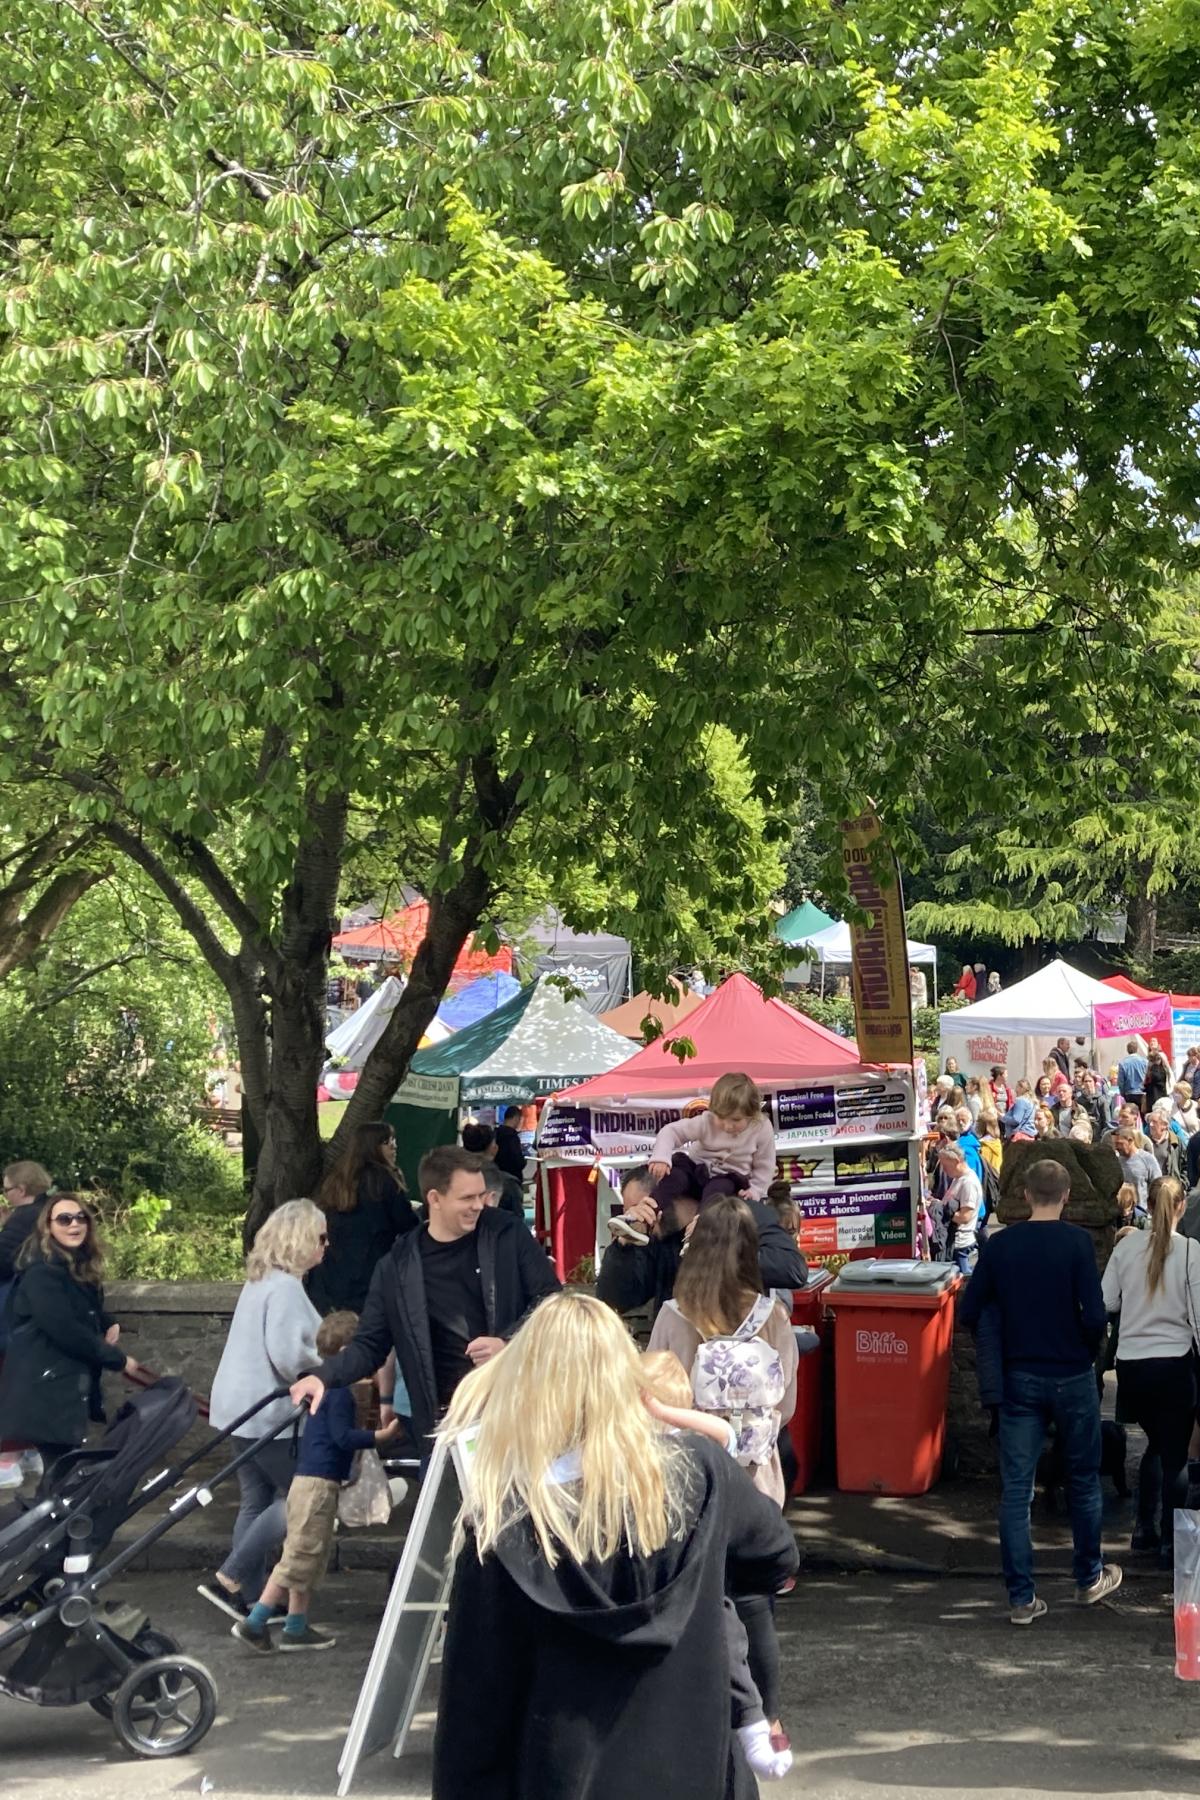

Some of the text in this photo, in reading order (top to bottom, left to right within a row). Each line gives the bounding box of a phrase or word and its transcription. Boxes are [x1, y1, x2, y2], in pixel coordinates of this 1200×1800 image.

[537, 1077, 579, 1090] TIMES
[810, 1092, 824, 1100] Free
[594, 1111, 636, 1134] INDIA
[836, 1125, 866, 1136] ANGLO
[875, 1121, 908, 1131] INDIAN
[787, 1128, 829, 1140] JAPANESE
[564, 1147, 603, 1157] MEDIUM
[609, 1145, 628, 1154] HOT
[829, 1194, 847, 1204] and
[849, 1191, 897, 1204] pioneering
[808, 1206, 828, 1216] U.K
[830, 1205, 860, 1215] shores
[880, 1230, 907, 1240] Videos
[856, 1330, 908, 1355] Biffa
